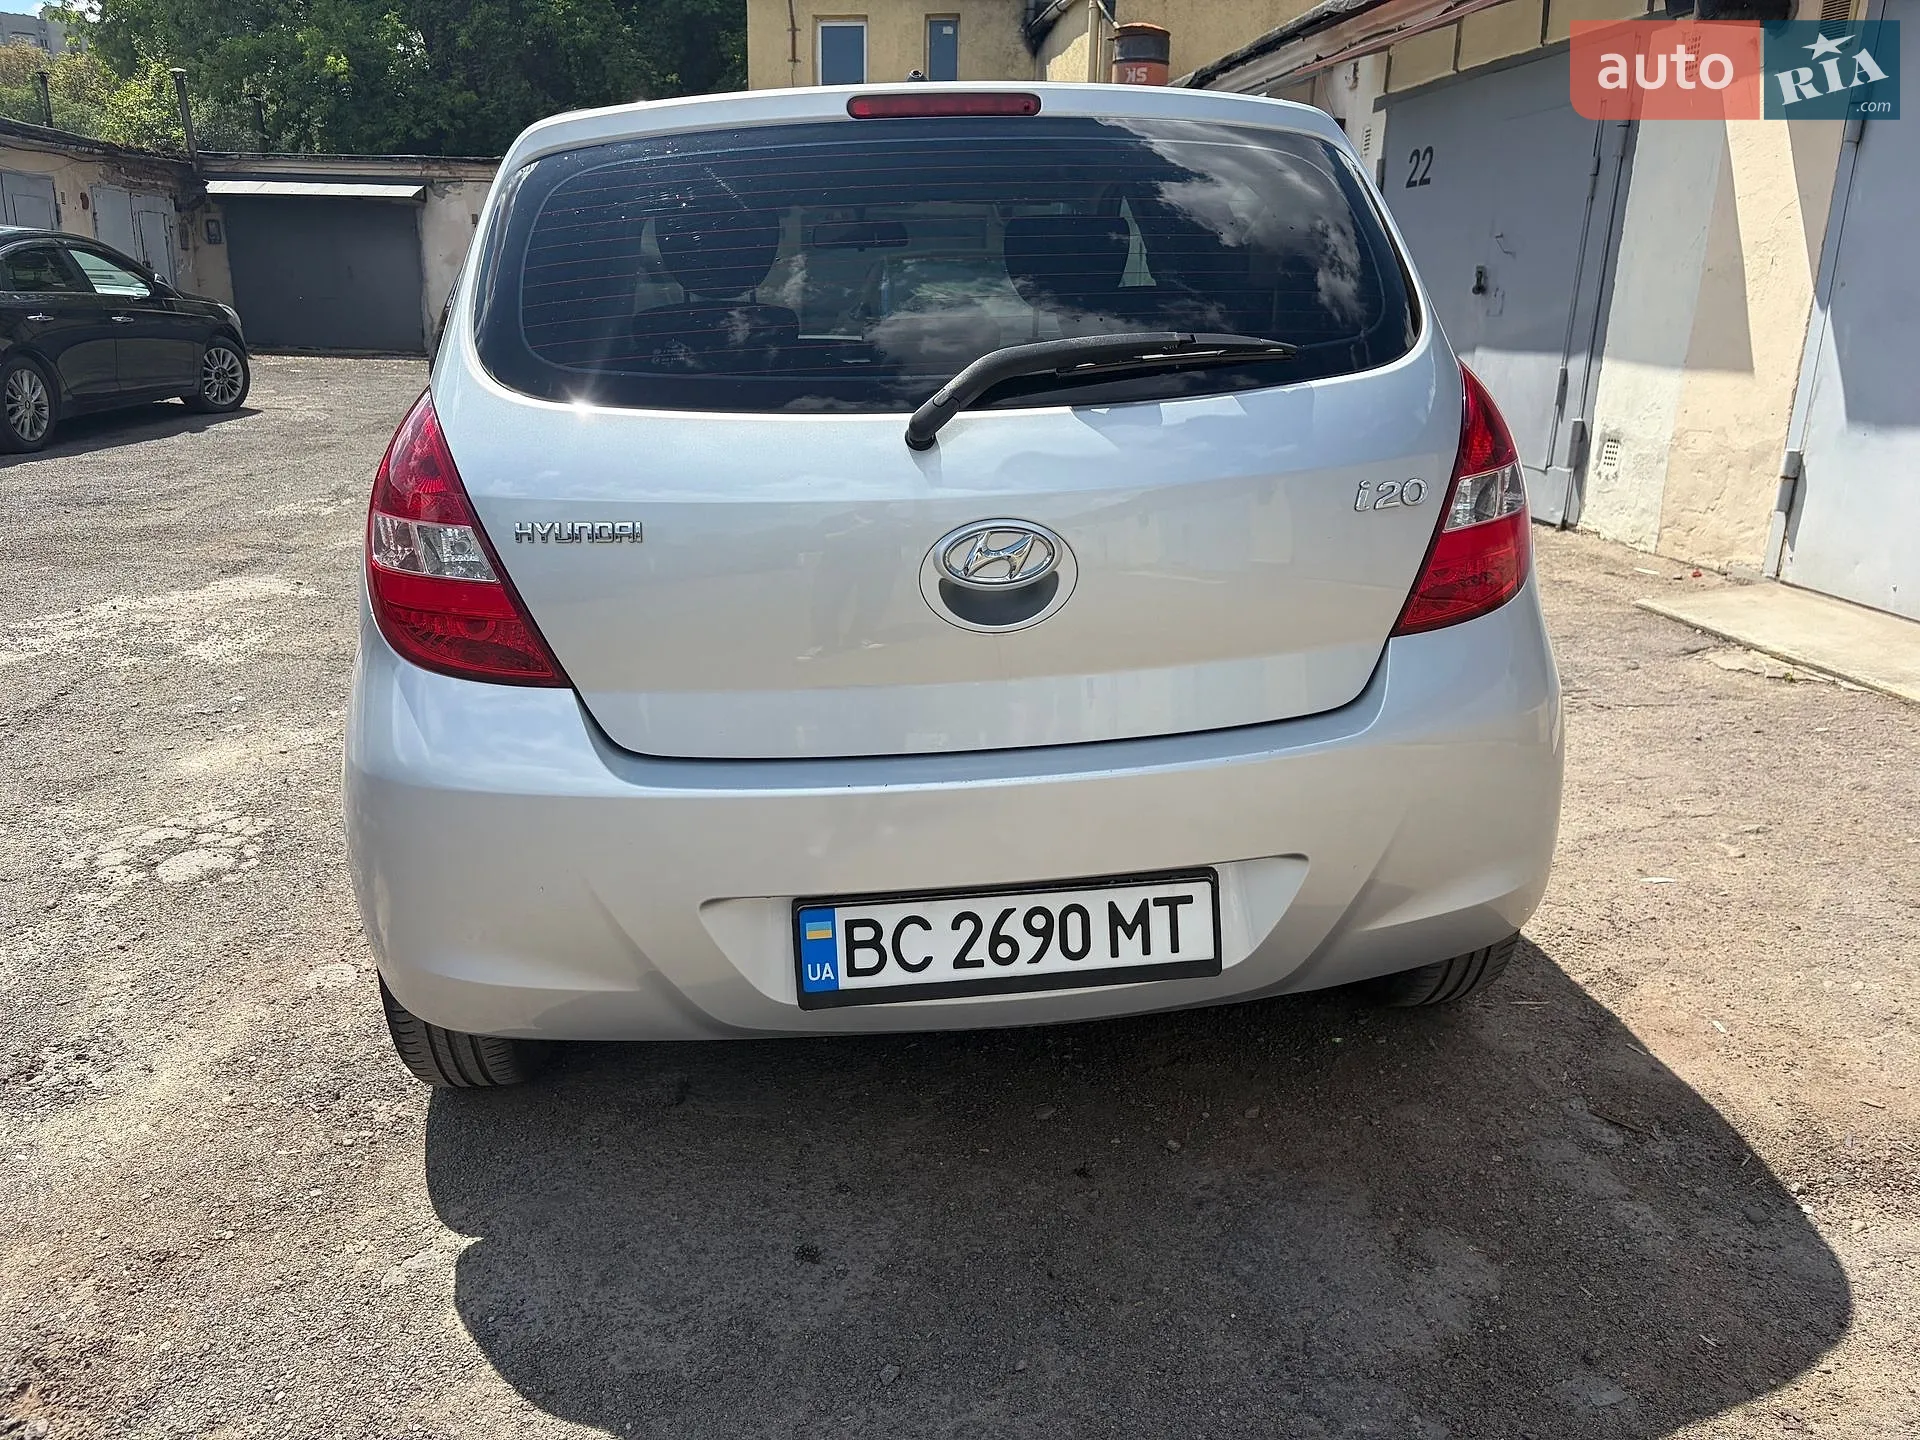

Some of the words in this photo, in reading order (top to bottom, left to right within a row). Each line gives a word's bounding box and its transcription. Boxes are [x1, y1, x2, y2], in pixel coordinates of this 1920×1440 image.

[1405, 145, 1434, 189] 22
[1354, 477, 1429, 512] i20
[514, 521, 643, 544] HYUNDAI
[844, 915, 934, 978] BC
[950, 903, 1092, 970] 2690
[1108, 894, 1194, 959] MT
[806, 962, 835, 981] UA
